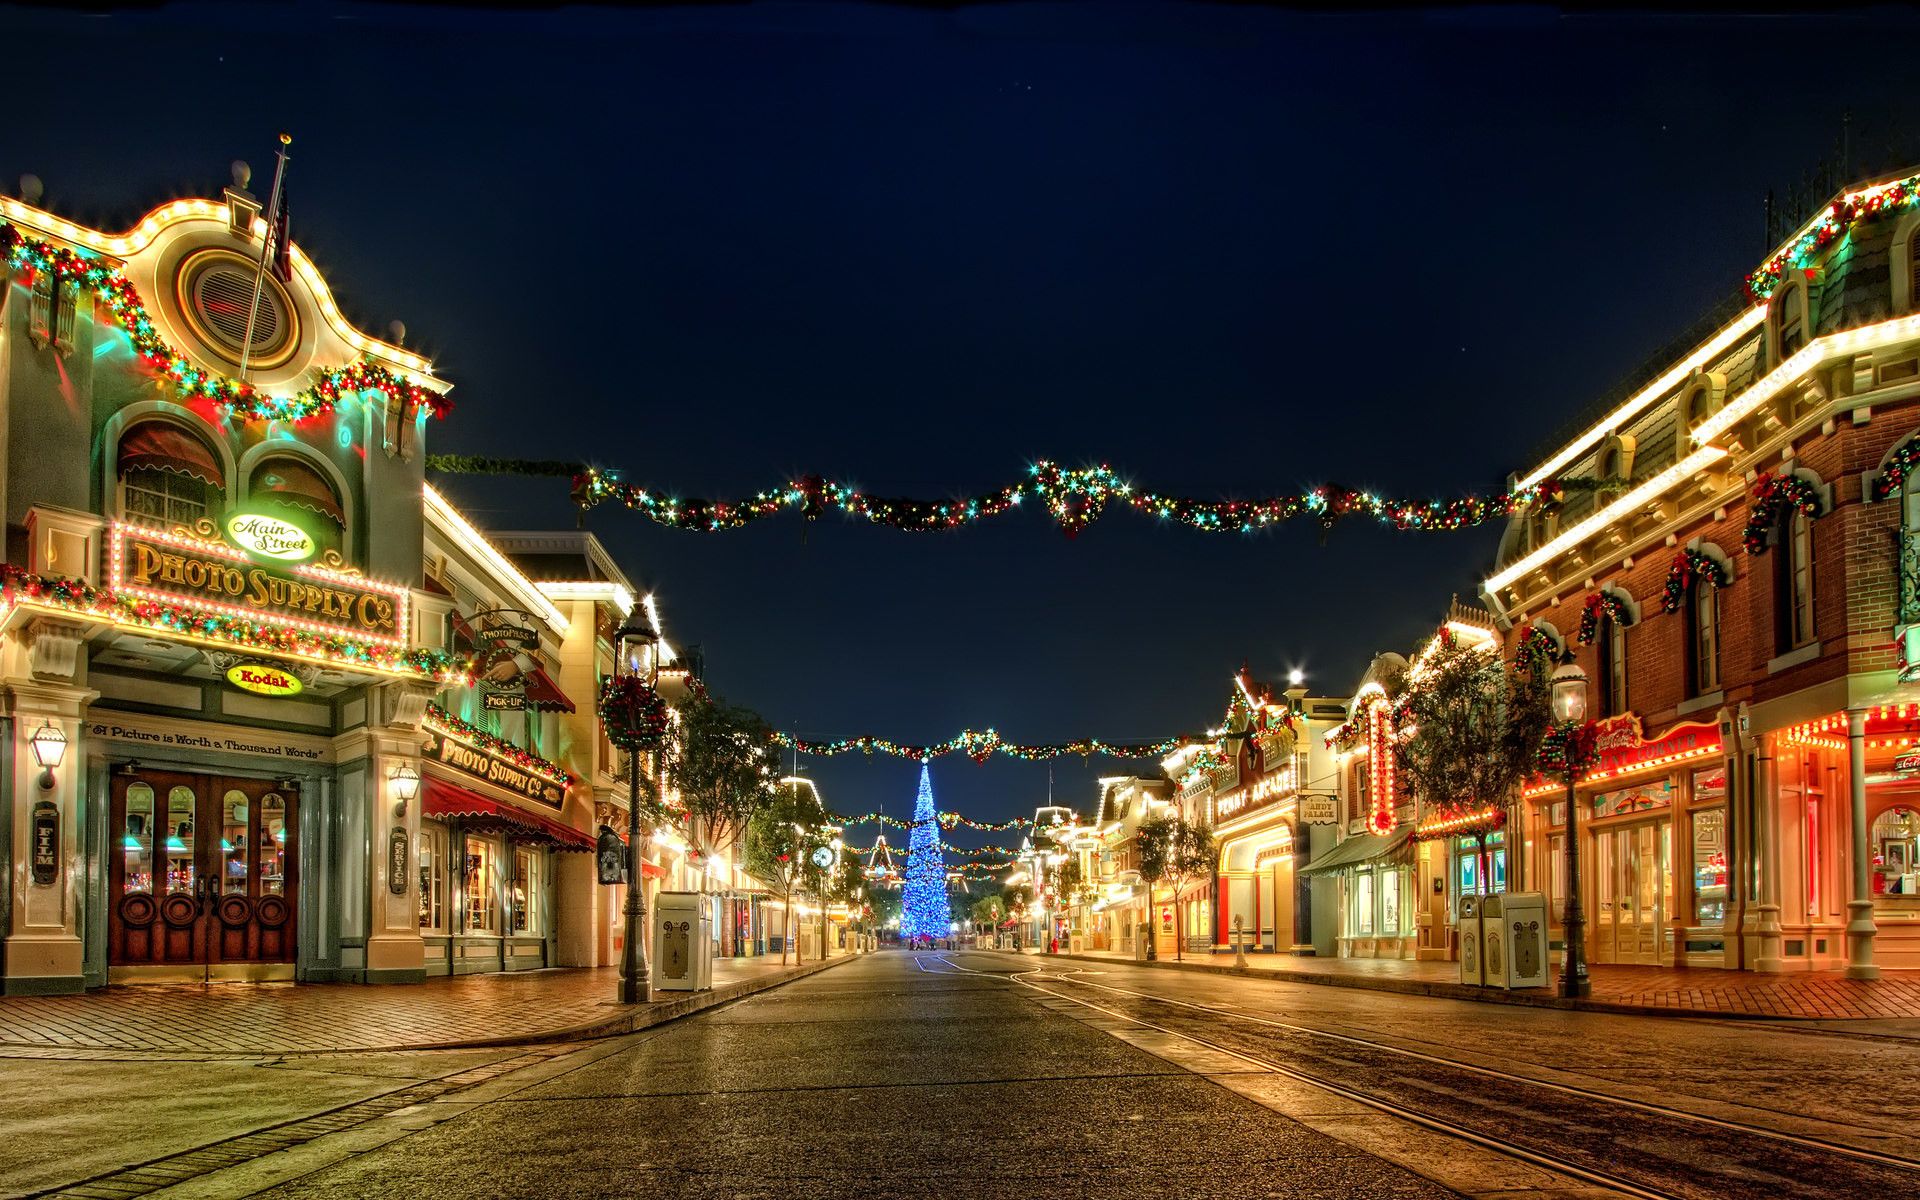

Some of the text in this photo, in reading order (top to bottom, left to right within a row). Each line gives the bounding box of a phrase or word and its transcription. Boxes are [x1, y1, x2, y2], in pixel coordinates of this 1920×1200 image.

[233, 518, 298, 538] Main
[255, 535, 308, 554] Street
[133, 542, 245, 596] PHOTO
[246, 569, 358, 619] SUPPLY
[241, 670, 289, 689] Kodak
[488, 696, 523, 706] PICK-UP
[111, 726, 160, 742] Picture
[163, 733, 174, 743] is
[174, 733, 211, 748] Worth
[213, 741, 222, 749] a
[224, 740, 282, 755] Thousand
[1638, 733, 1697, 761] CORNER
[440, 738, 488, 773] PHOTO
[488, 760, 529, 790] SUPPLY
[1218, 770, 1292, 816] PENNY ARCADE
[36, 827, 55, 865] FILM
